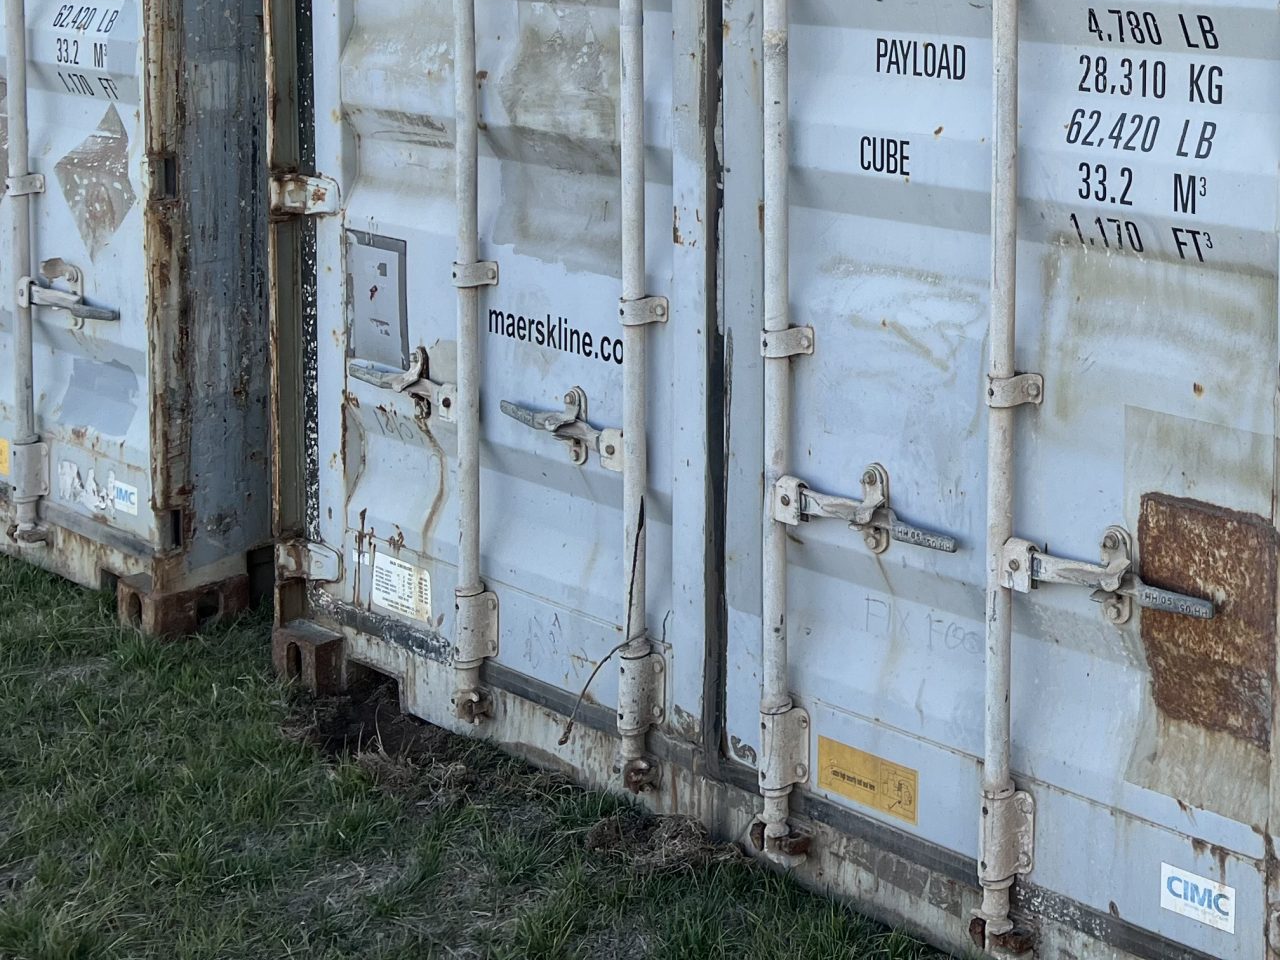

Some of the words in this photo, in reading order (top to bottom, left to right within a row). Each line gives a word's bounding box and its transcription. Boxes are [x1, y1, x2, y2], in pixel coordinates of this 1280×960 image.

[96, 9, 119, 33] LB
[1178, 13, 1220, 50] LB
[876, 38, 966, 81] PAYLOAD
[1189, 63, 1224, 104] KG
[1176, 120, 1217, 159] LB
[860, 136, 910, 176] CUBE
[1078, 162, 1134, 206] 33.2
[488, 309, 623, 365] maerskline.co
[1167, 876, 1230, 917] CIMC
